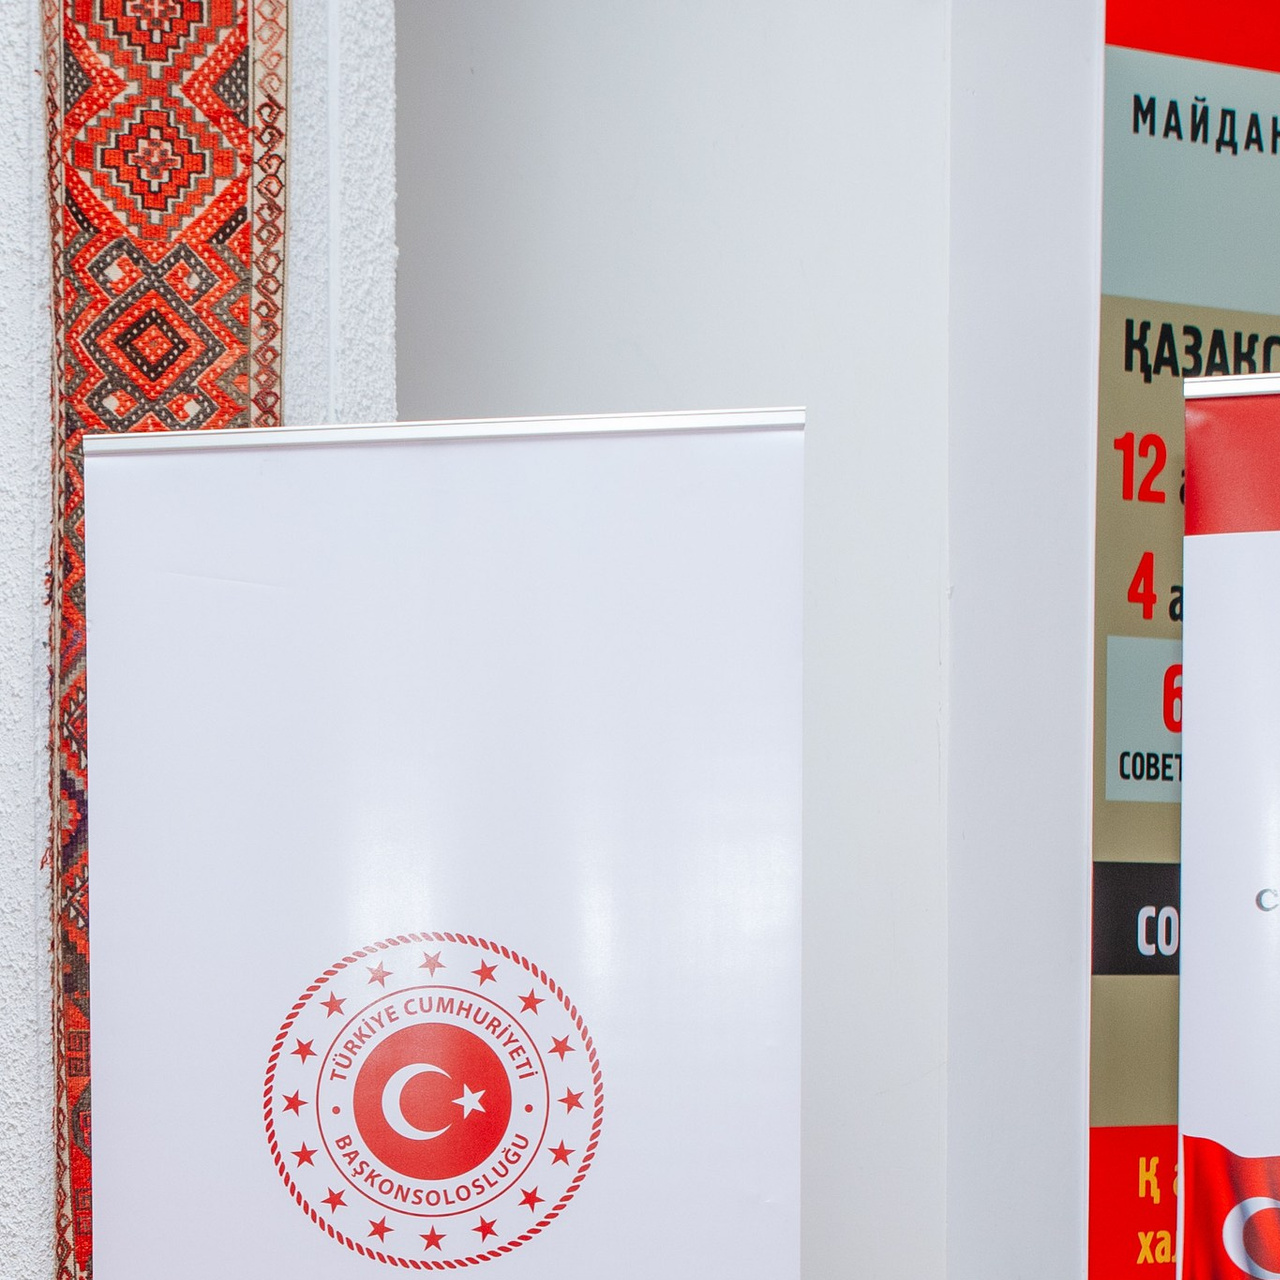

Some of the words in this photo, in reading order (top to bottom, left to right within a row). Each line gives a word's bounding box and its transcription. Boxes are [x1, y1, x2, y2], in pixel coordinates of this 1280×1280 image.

[1114, 432, 1167, 504] 12
[1127, 551, 1157, 621] 4
[329, 1004, 400, 1083] TÜRKİYE
[403, 996, 539, 1081] CUMHURİYETİ
[334, 1132, 531, 1208] BAŞKONSOLOSLUĞU
